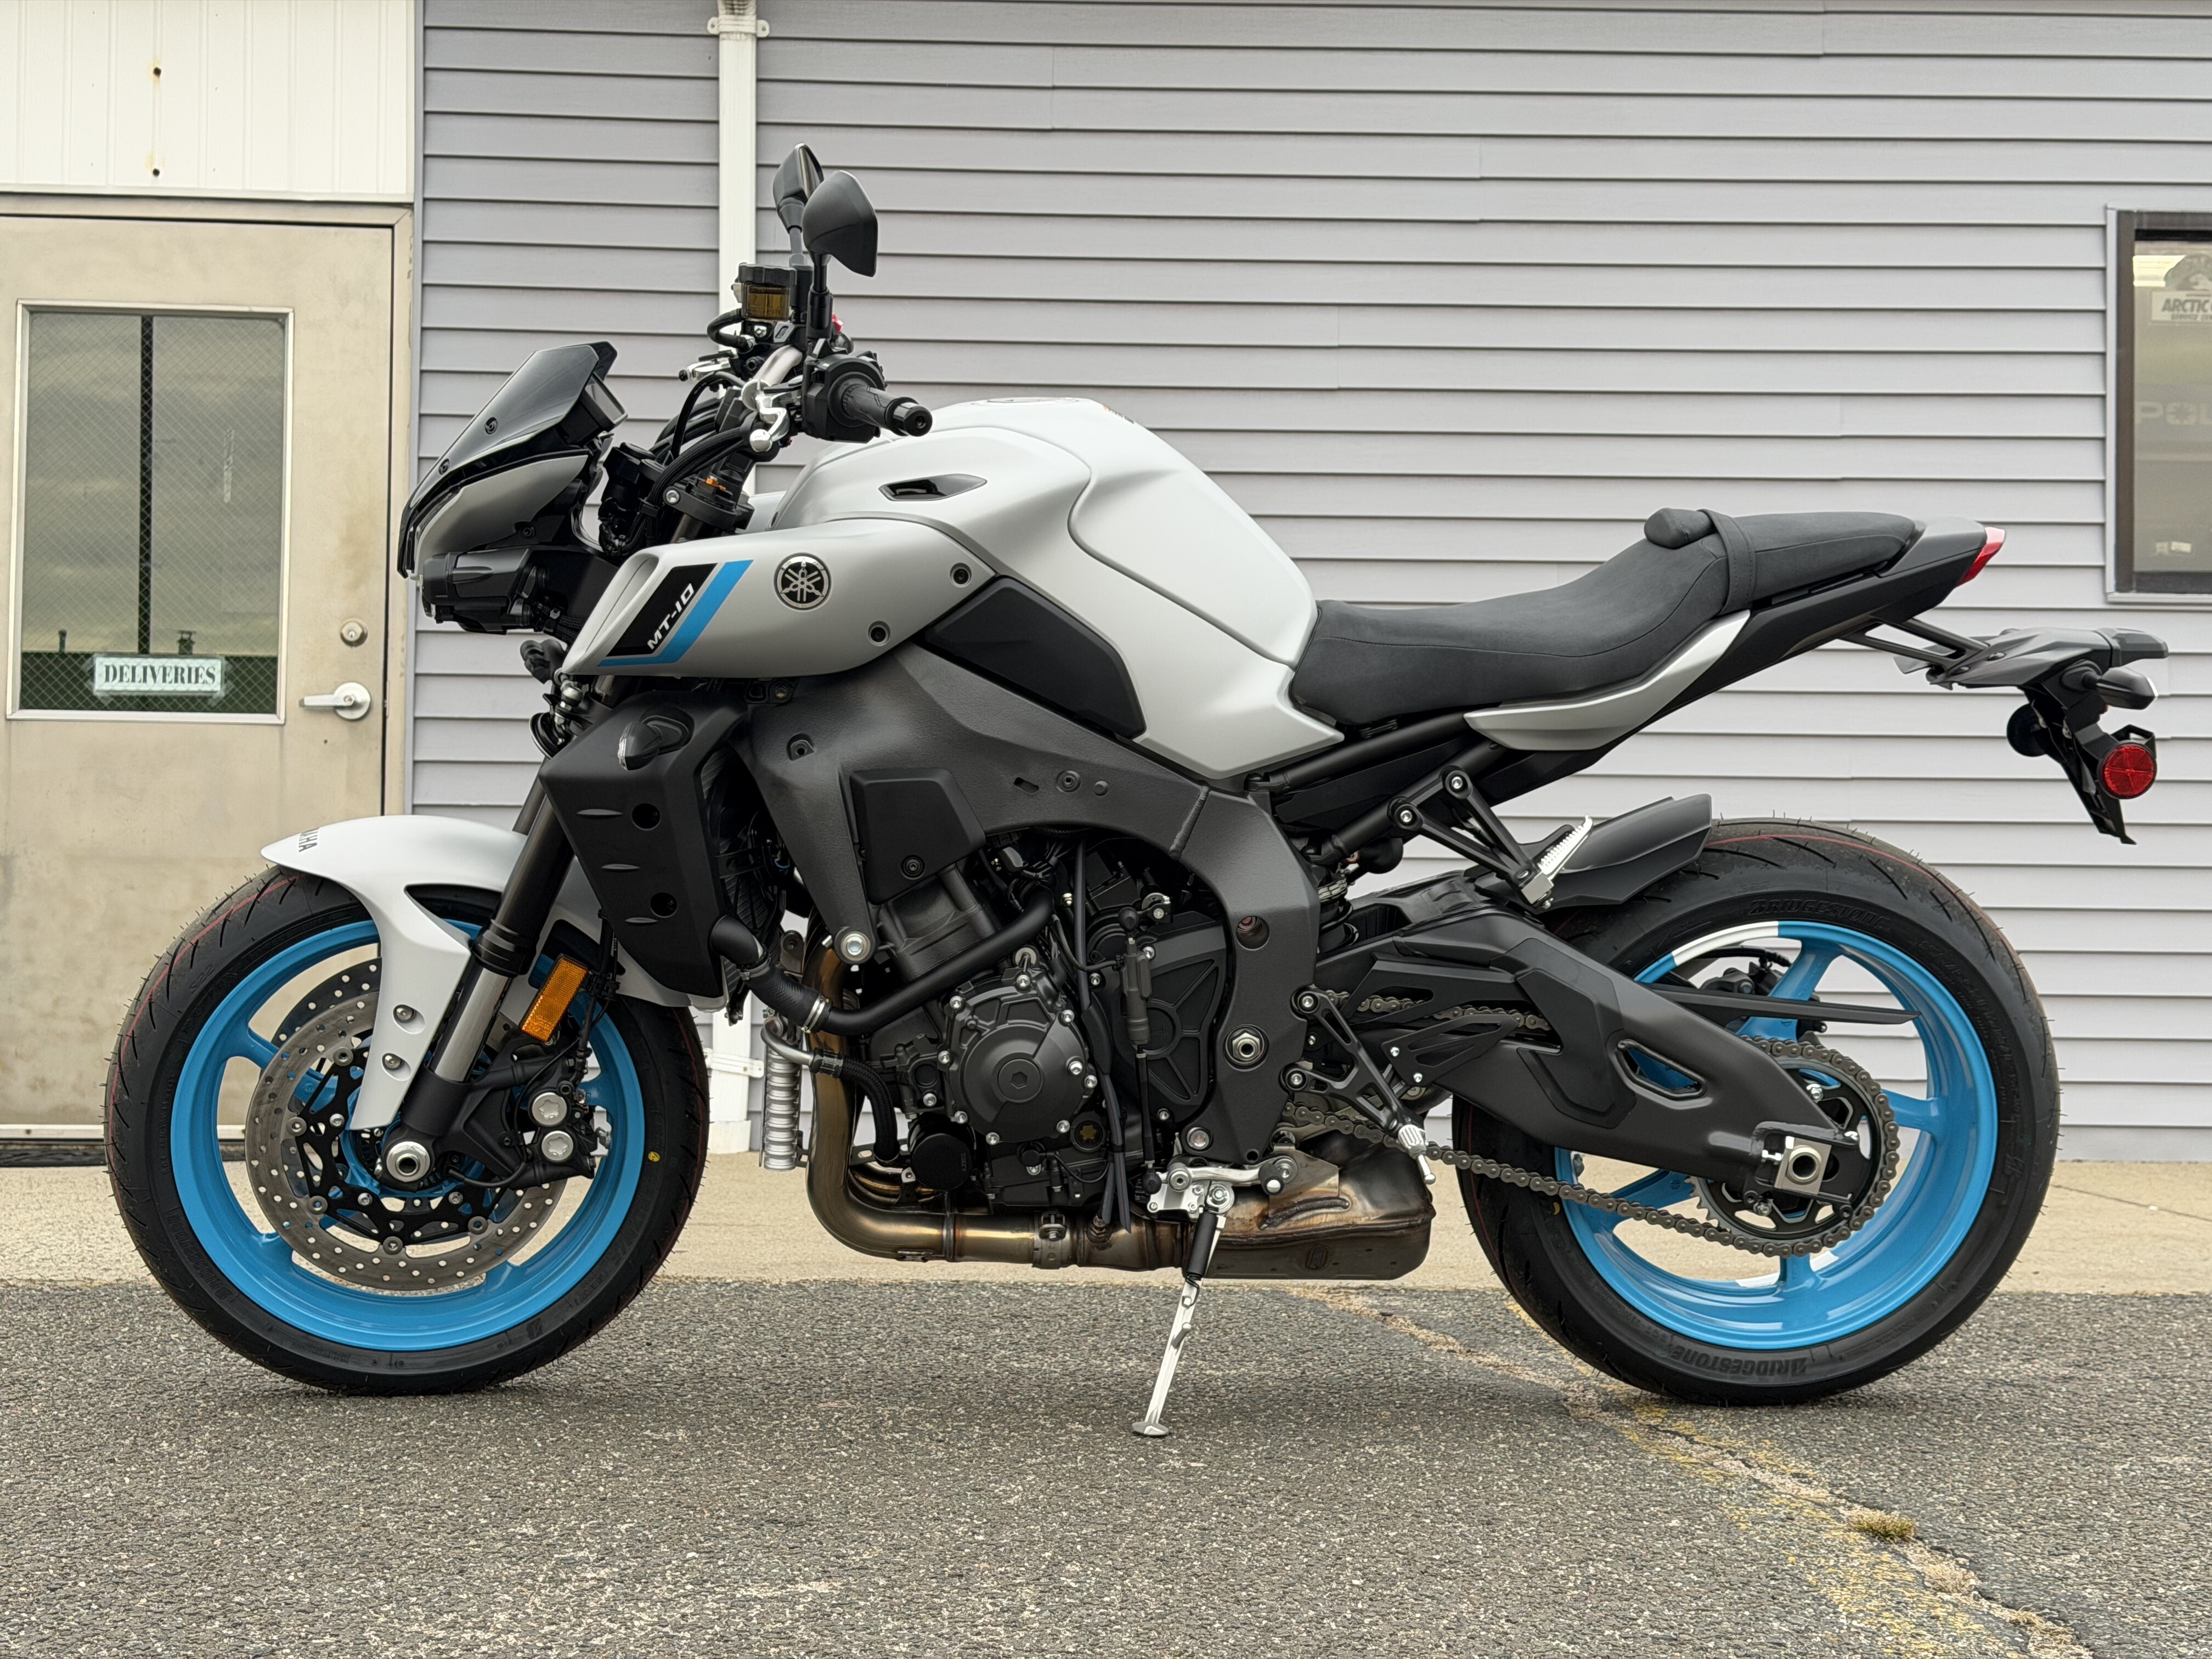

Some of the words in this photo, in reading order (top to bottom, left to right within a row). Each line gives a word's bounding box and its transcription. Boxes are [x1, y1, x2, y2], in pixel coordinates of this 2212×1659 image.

[2162, 298, 2210, 313] ARCTIC
[647, 583, 694, 650] MT-10
[104, 664, 216, 686] DELIVERIES
[1747, 898, 1891, 930] BRIDGESTONE
[1670, 1344, 1807, 1377] BRIDGESTONE
